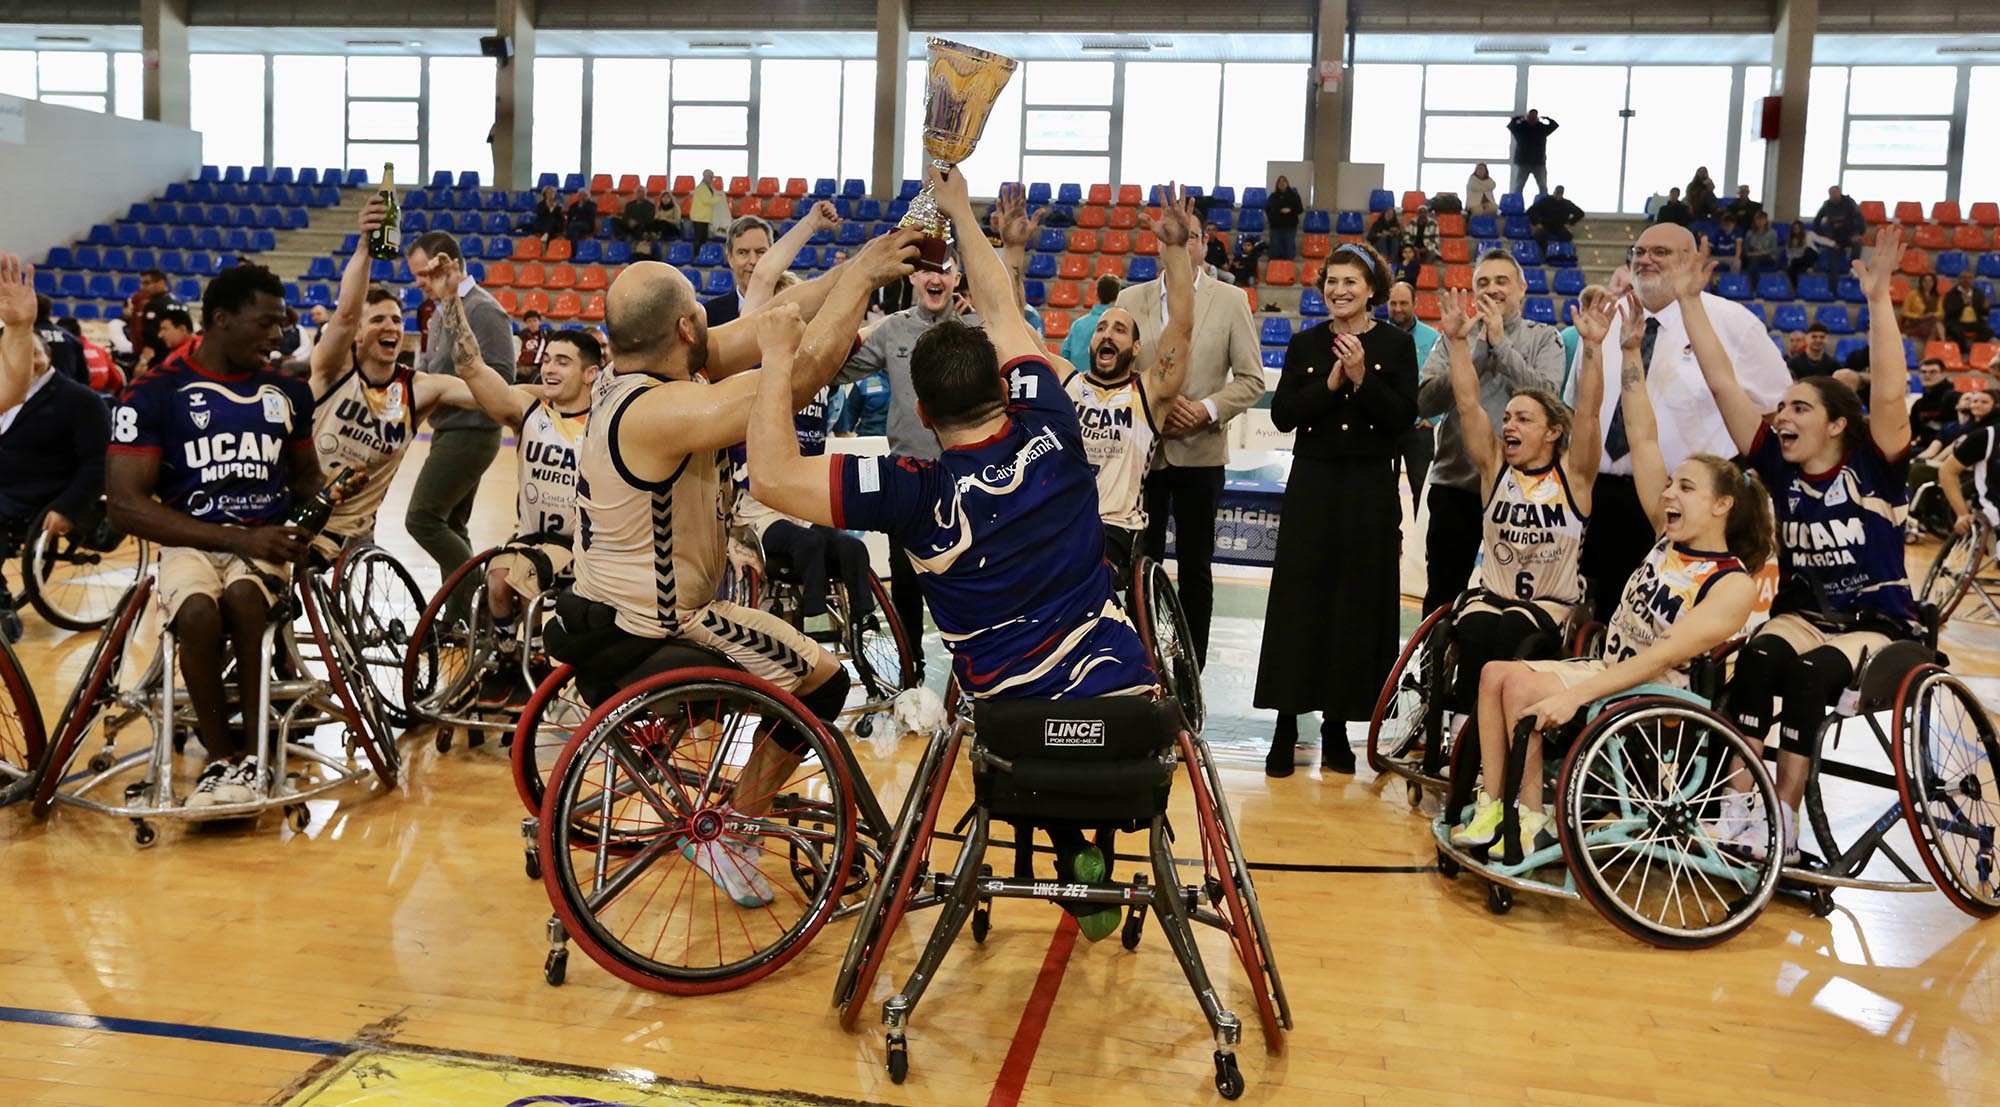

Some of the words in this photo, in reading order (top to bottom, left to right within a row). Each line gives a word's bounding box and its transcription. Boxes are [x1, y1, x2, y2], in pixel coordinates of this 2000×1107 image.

[338, 425, 393, 455] MURCIA
[1080, 426, 1121, 441] URCIA
[184, 432, 283, 469] UCAM
[525, 440, 577, 471] UCA
[201, 462, 269, 483] MURCIA
[531, 468, 576, 487] MURCI
[1491, 501, 1567, 528] UCAM
[1499, 528, 1555, 545] MURCIA
[1782, 517, 1866, 551] UCAM
[1515, 571, 1535, 600] 6
[1047, 722, 1103, 737] LINCE
[1033, 882, 1060, 896] LINCE
[1062, 883, 1089, 898] 2EZ
